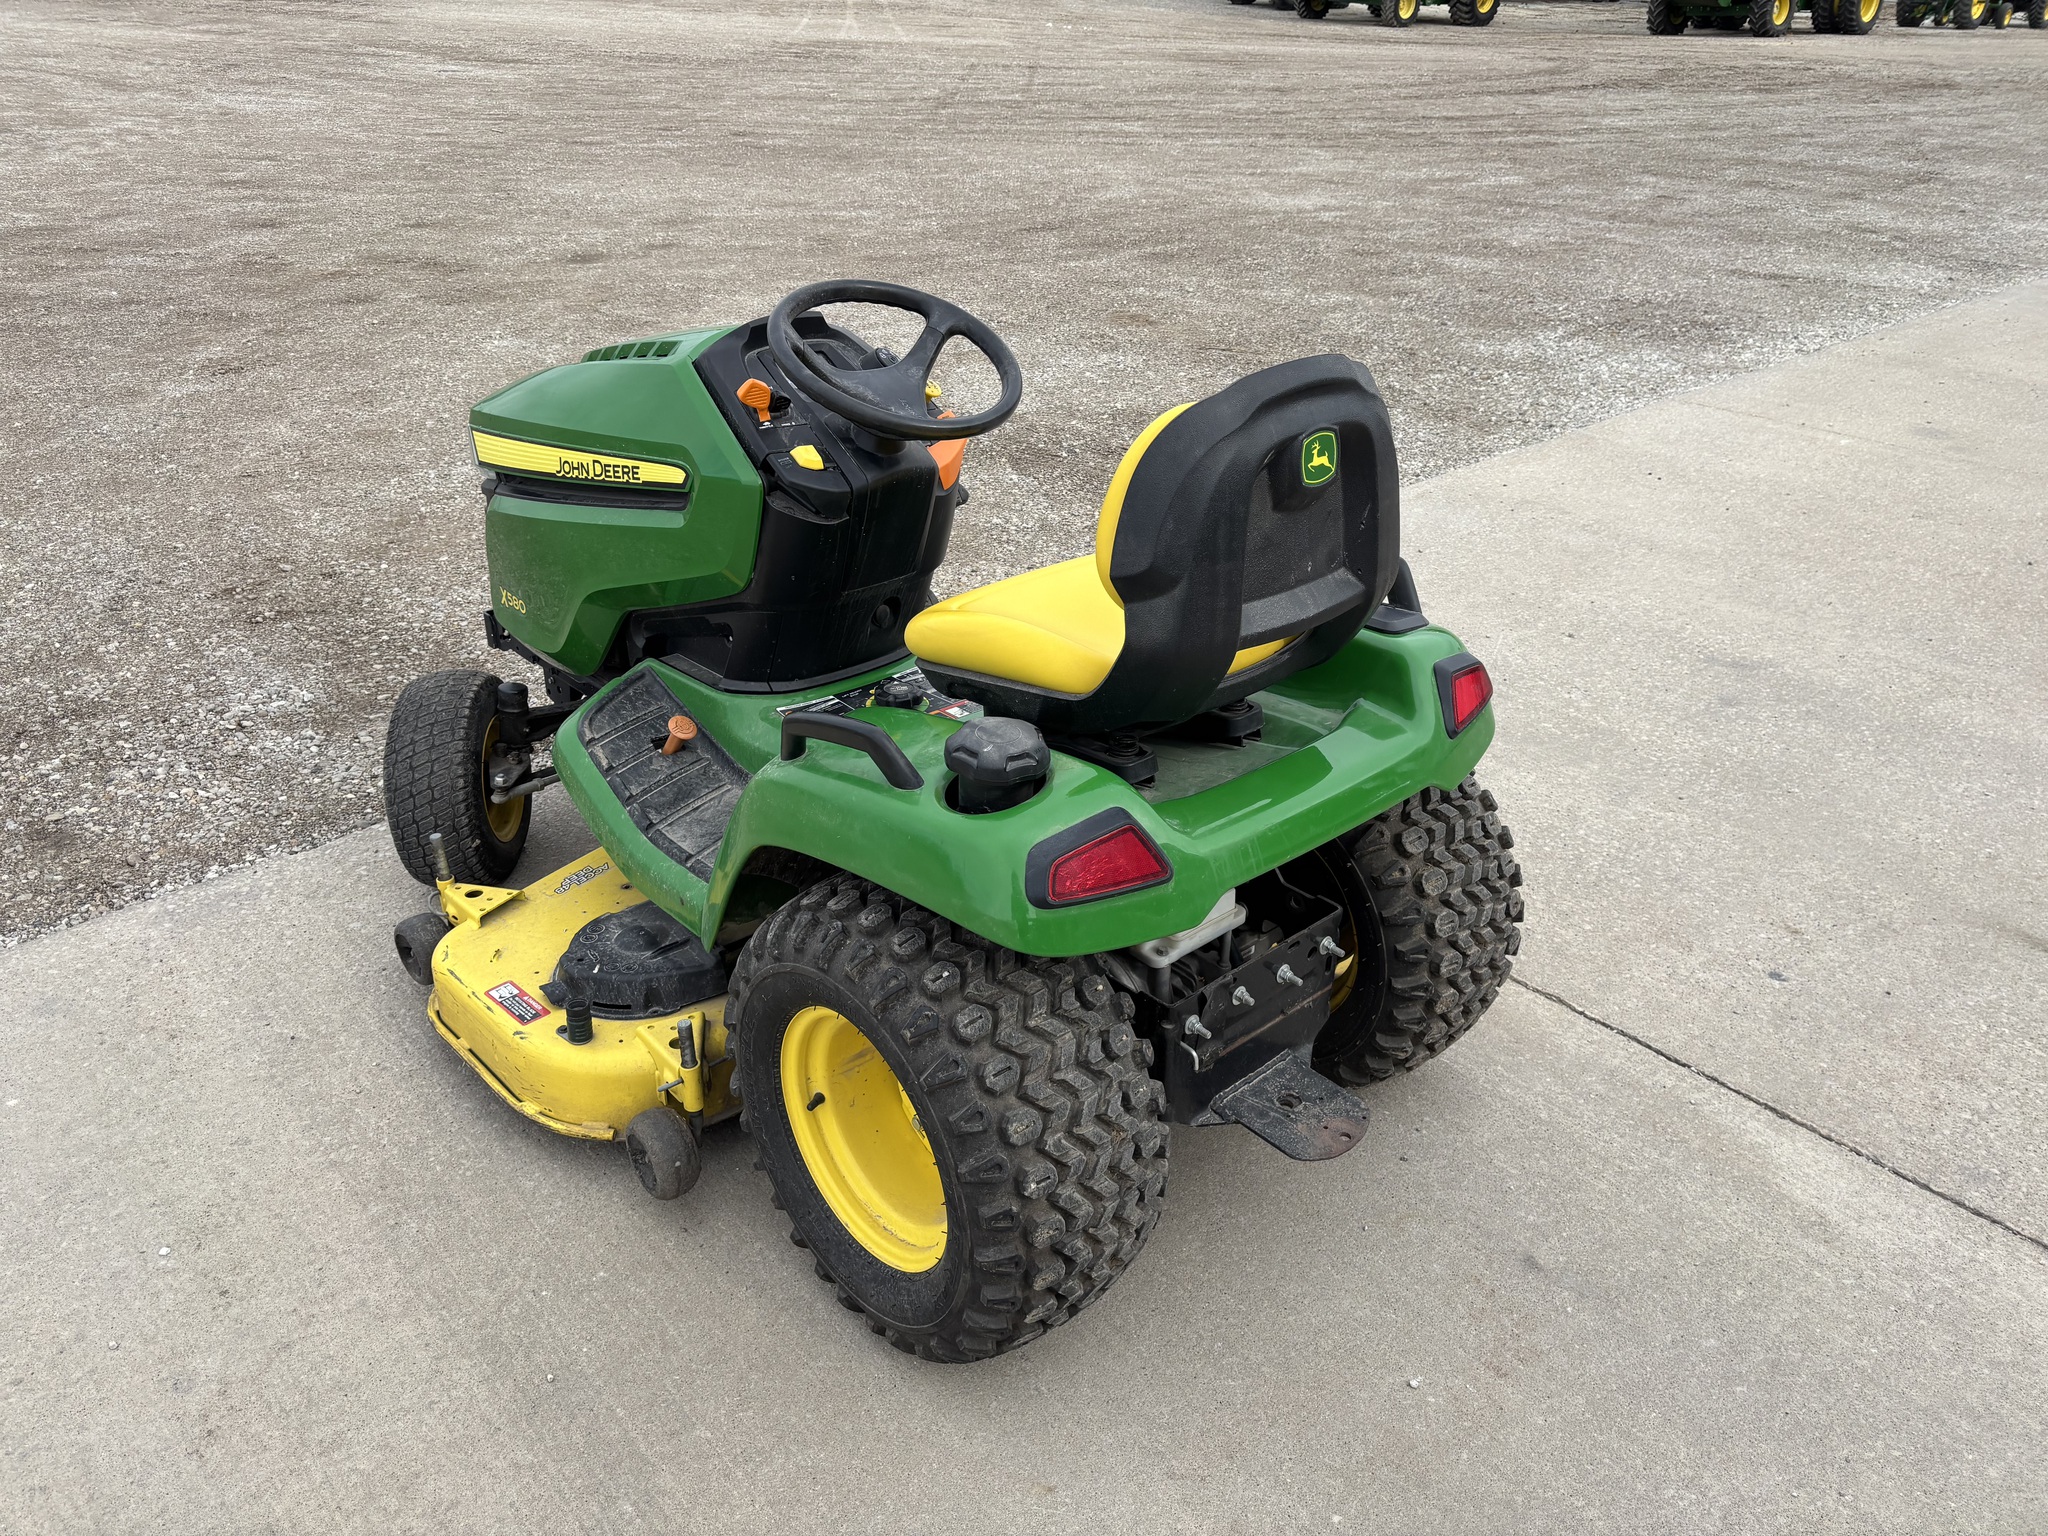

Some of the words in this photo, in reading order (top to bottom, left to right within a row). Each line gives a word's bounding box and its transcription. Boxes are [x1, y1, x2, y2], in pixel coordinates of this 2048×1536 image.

[556, 456, 590, 478] JOHN
[592, 459, 641, 481] DEERE
[499, 586, 527, 614] X580
[561, 865, 594, 887] DEEP
[570, 862, 610, 886] ACCEL
[554, 884, 571, 895] 48
